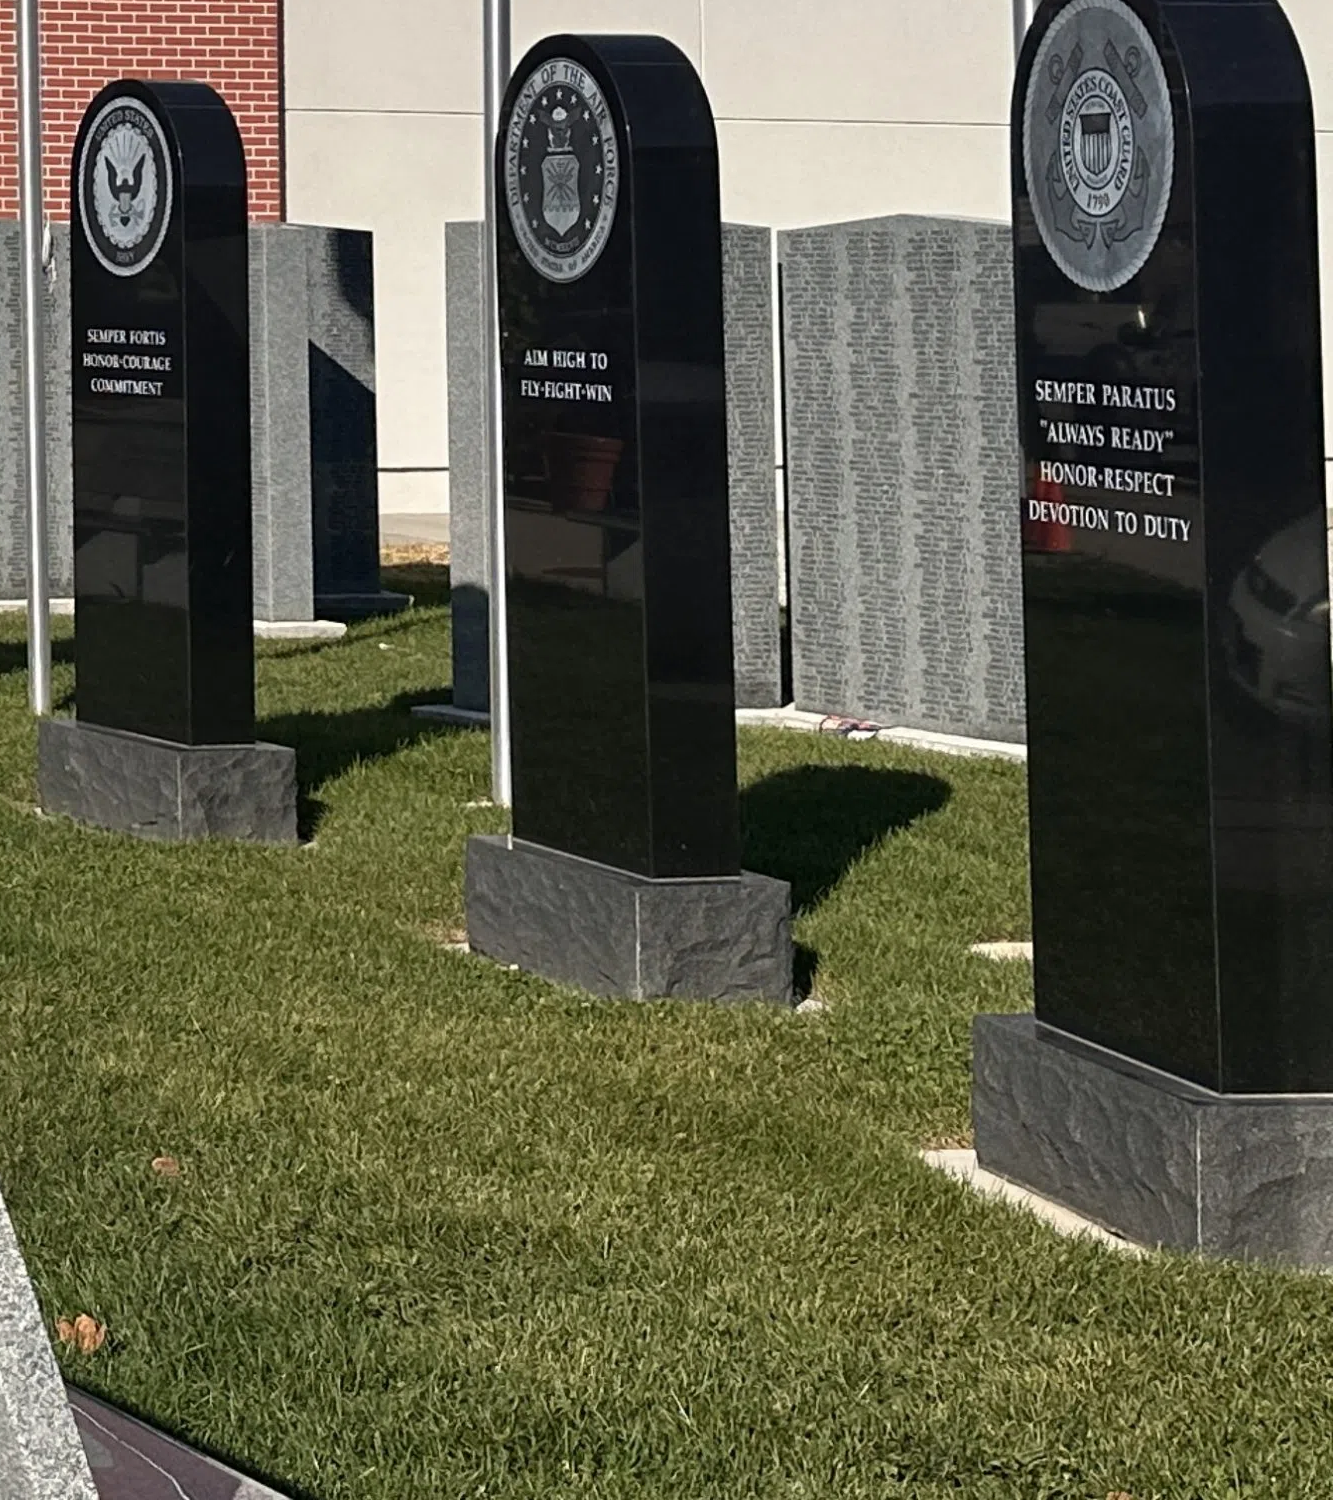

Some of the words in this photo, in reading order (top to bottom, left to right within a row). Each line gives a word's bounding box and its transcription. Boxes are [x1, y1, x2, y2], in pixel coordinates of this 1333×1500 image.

[541, 64, 557, 84] OF
[563, 64, 587, 90] THE
[87, 328, 127, 344] SEMPER
[129, 330, 166, 346] FORTIS
[524, 349, 549, 367] AIM
[553, 350, 586, 369] HIGH
[590, 352, 608, 370] TO
[91, 378, 163, 396] COMMITMENT
[1035, 379, 1096, 406] SEMPER
[1102, 384, 1176, 412] PARATUS
[1028, 499, 1110, 531] DEVOTION
[1114, 510, 1138, 535] TO
[1143, 513, 1192, 542] DUTY
